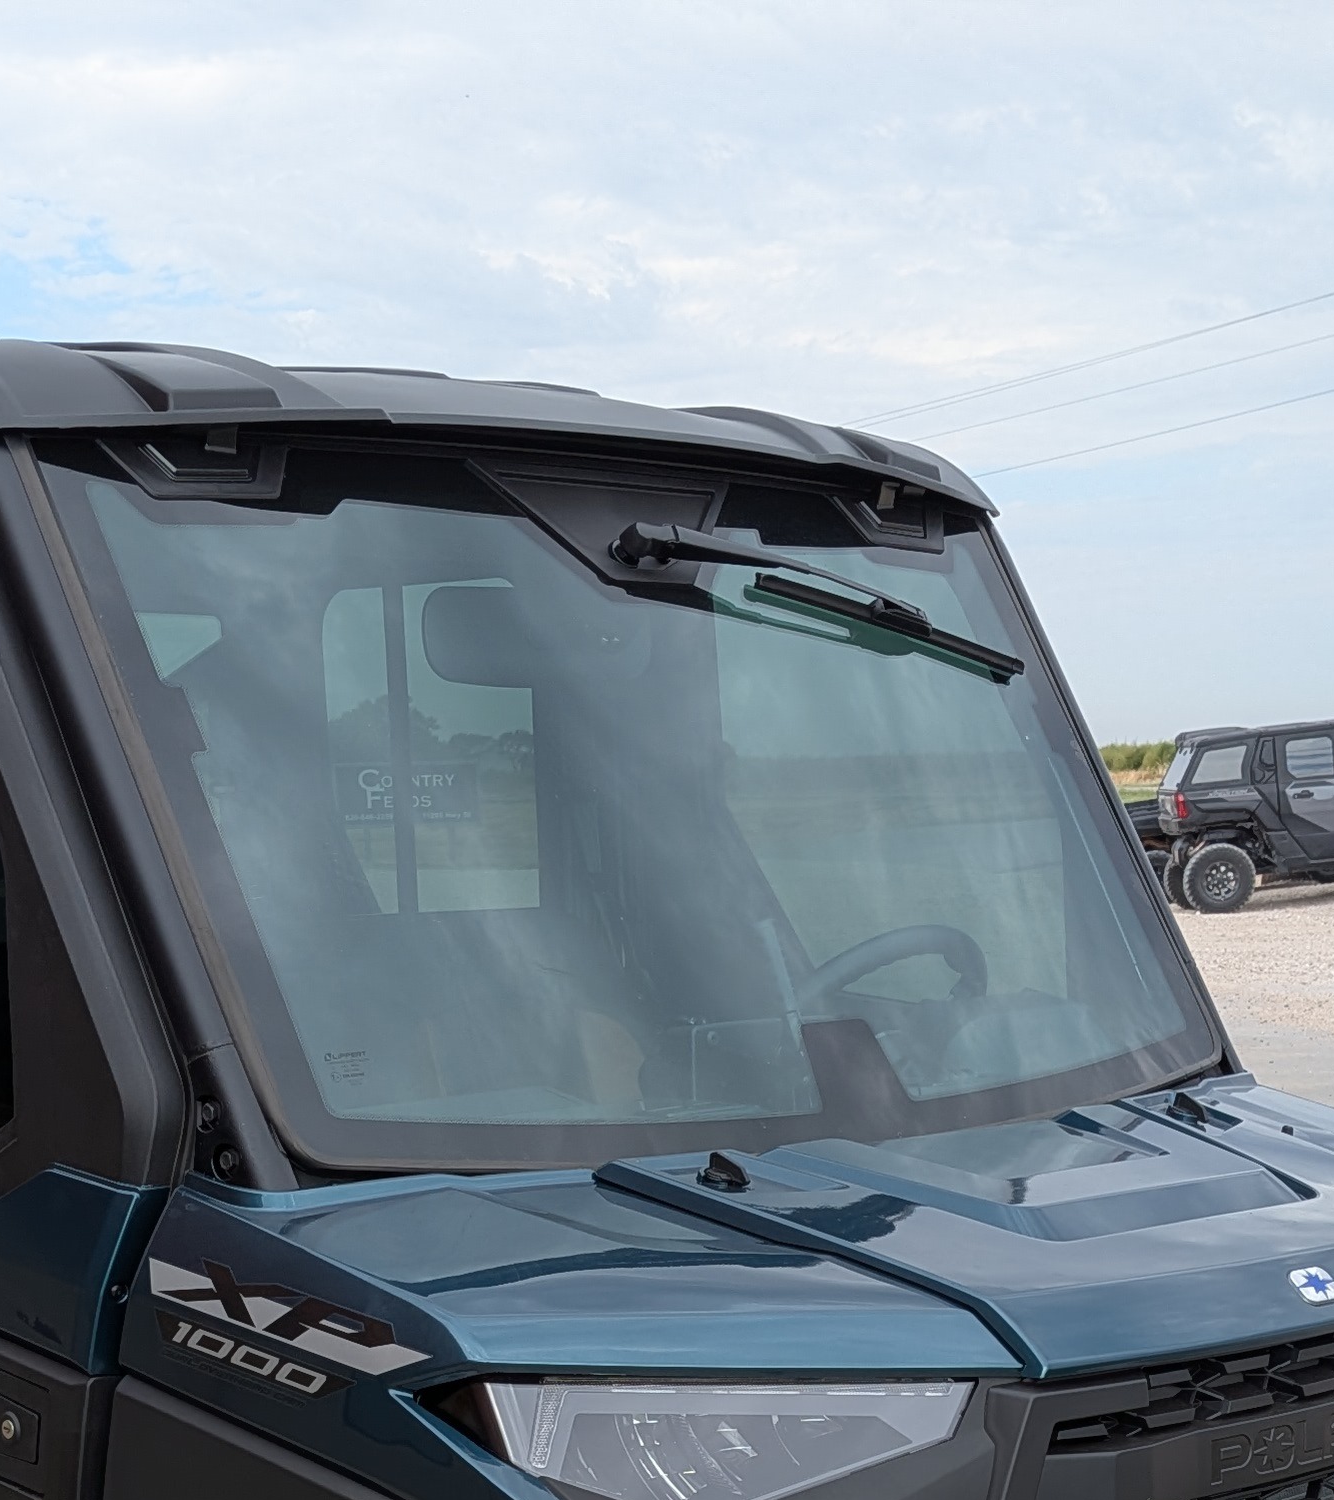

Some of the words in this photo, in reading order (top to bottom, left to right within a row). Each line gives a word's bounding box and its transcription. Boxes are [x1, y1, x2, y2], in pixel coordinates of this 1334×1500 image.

[357, 768, 455, 791] CONTRY
[365, 786, 433, 809] FEDS
[157, 1256, 398, 1349] XP
[171, 1320, 328, 1394] 1000
